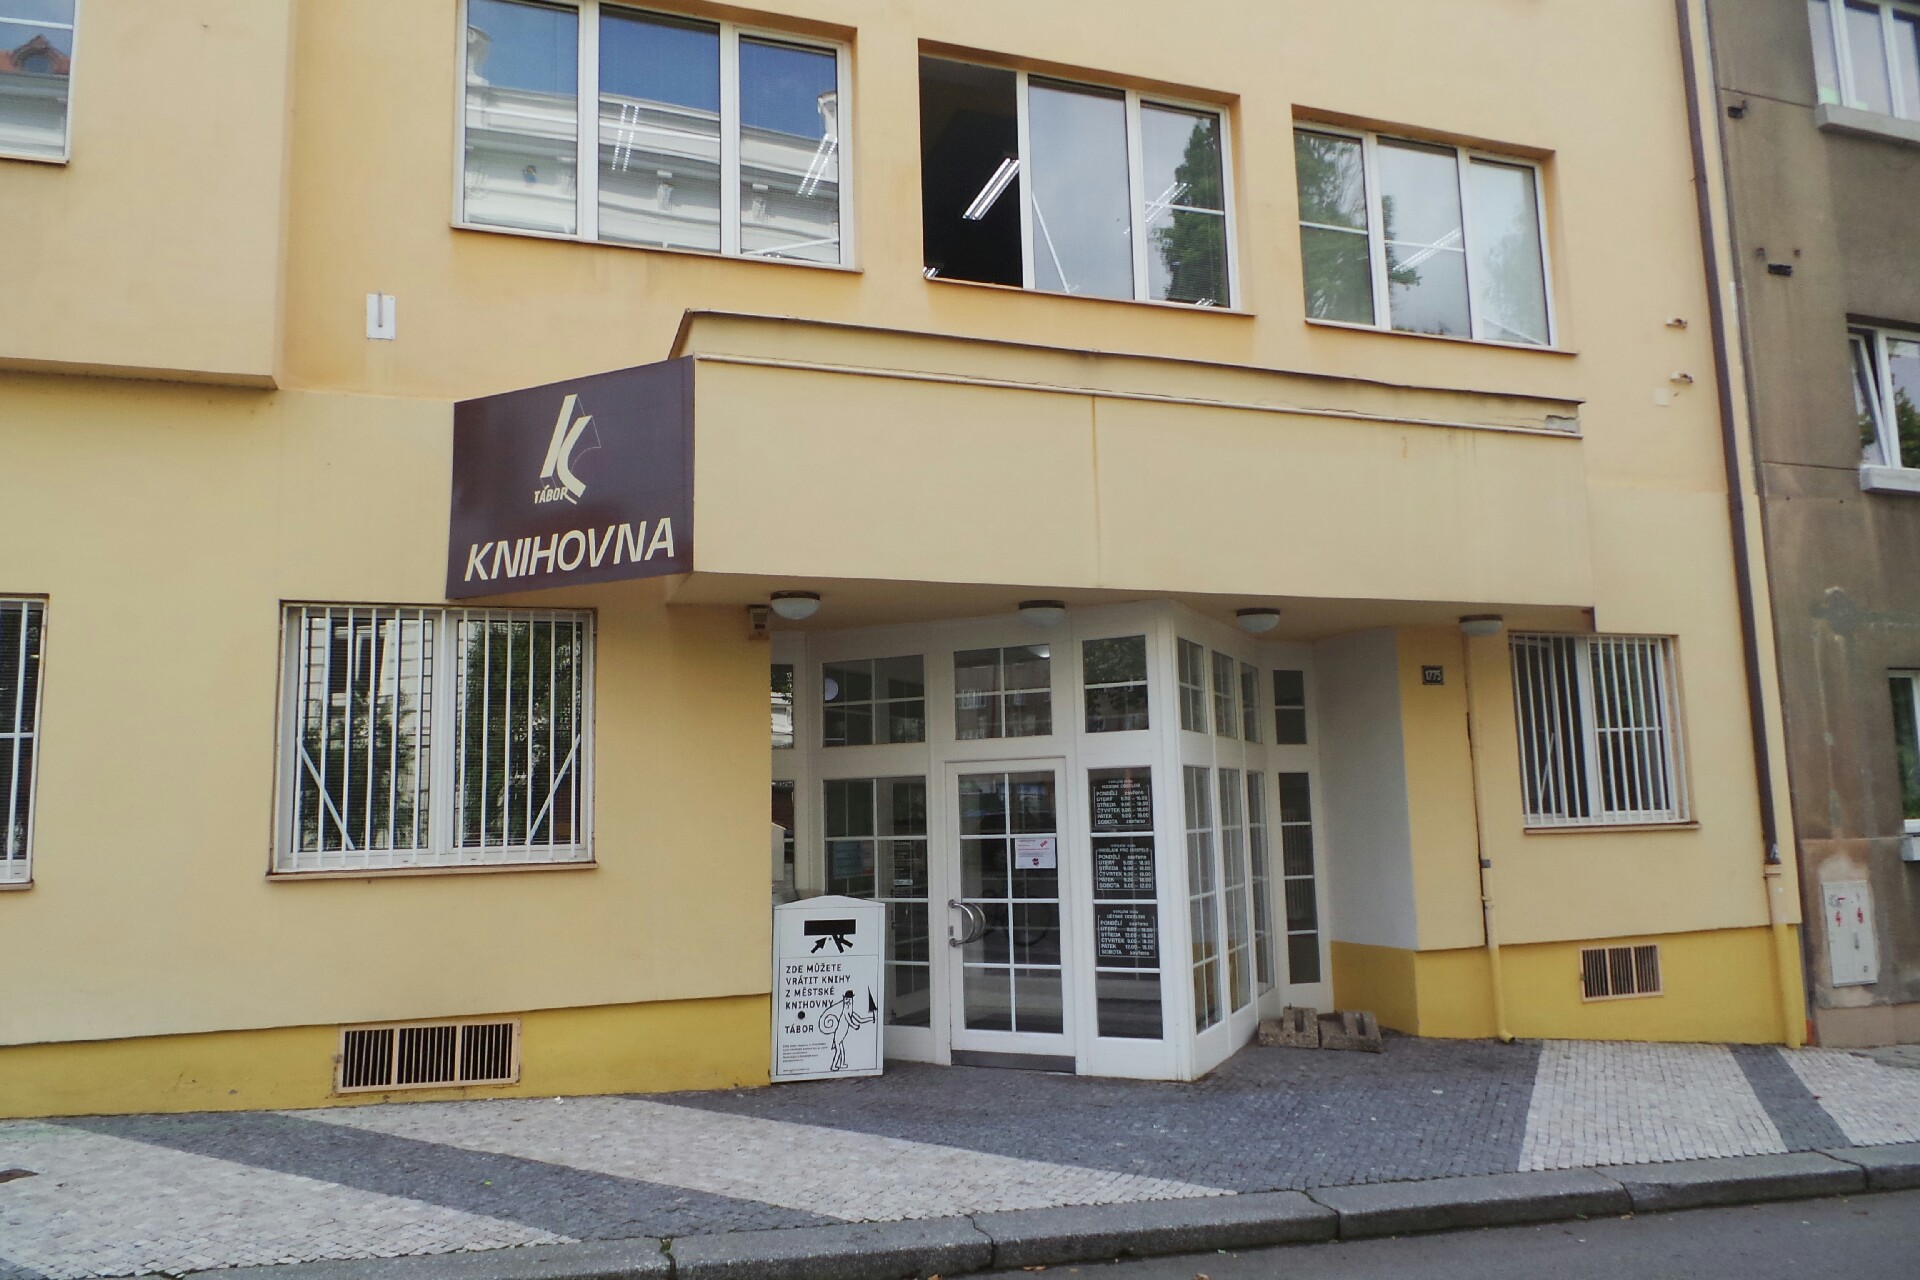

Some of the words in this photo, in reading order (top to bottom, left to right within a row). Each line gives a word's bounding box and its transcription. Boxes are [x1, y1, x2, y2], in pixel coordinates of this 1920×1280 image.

[534, 485, 577, 505] TÁBOR
[464, 517, 675, 582] KNIHOVNA
[786, 965, 803, 974] ZDE
[806, 963, 842, 973] MŮŽETE
[785, 975, 818, 986] VRÁTIT
[821, 974, 851, 984] KNIHY
[785, 989, 791, 998] Z
[794, 985, 835, 997] MĚSTSKÉ
[785, 999, 834, 1010] KNIHOVNY
[785, 1024, 814, 1034] TÁBOR
